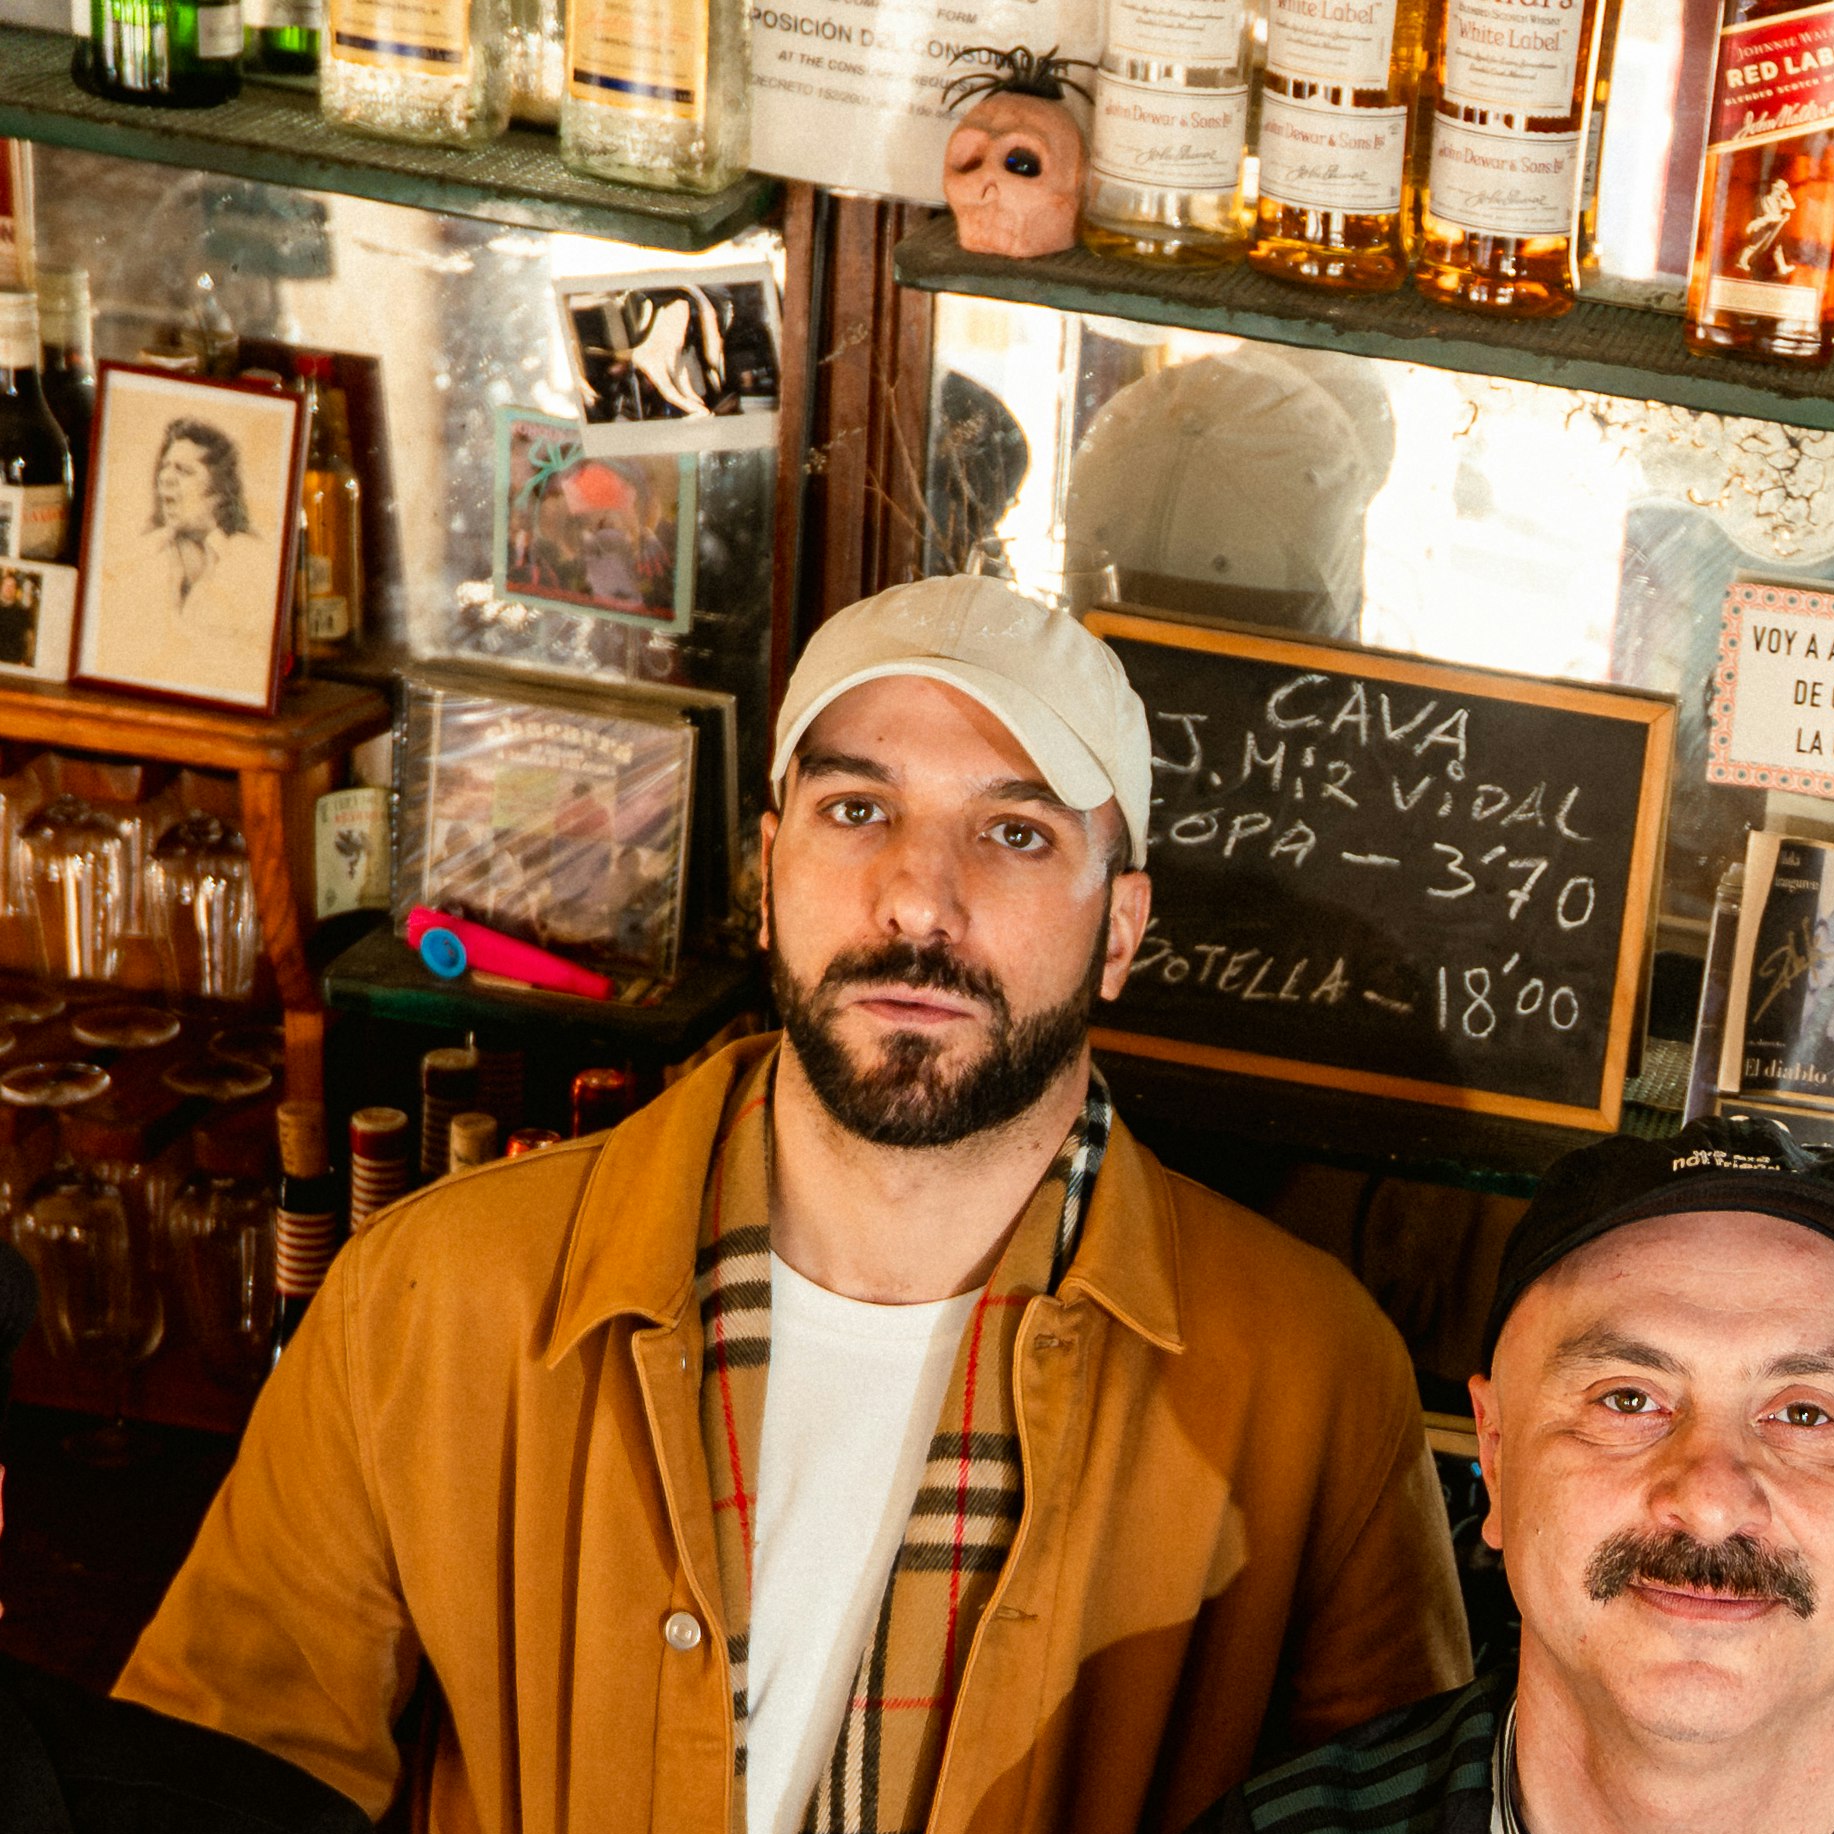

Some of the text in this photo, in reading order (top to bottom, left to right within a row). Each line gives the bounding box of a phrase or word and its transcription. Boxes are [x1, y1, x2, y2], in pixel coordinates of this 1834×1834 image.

[936, 8, 978, 24] FORM
[1726, 60, 1779, 89] RED
[1724, 88, 1774, 106] BLENDED
[1777, 78, 1820, 94] SCOTCH
[1752, 624, 1796, 658] VOY
[1803, 633, 1820, 660] A
[1793, 679, 1822, 708] DE
[1266, 673, 1470, 761] CAVA
[1795, 727, 1822, 756] LA
[1148, 797, 1318, 867] OPA
[1437, 952, 1580, 1039] 18'00
[1744, 1057, 1760, 1078] El
[1763, 1059, 1828, 1085] diablo
